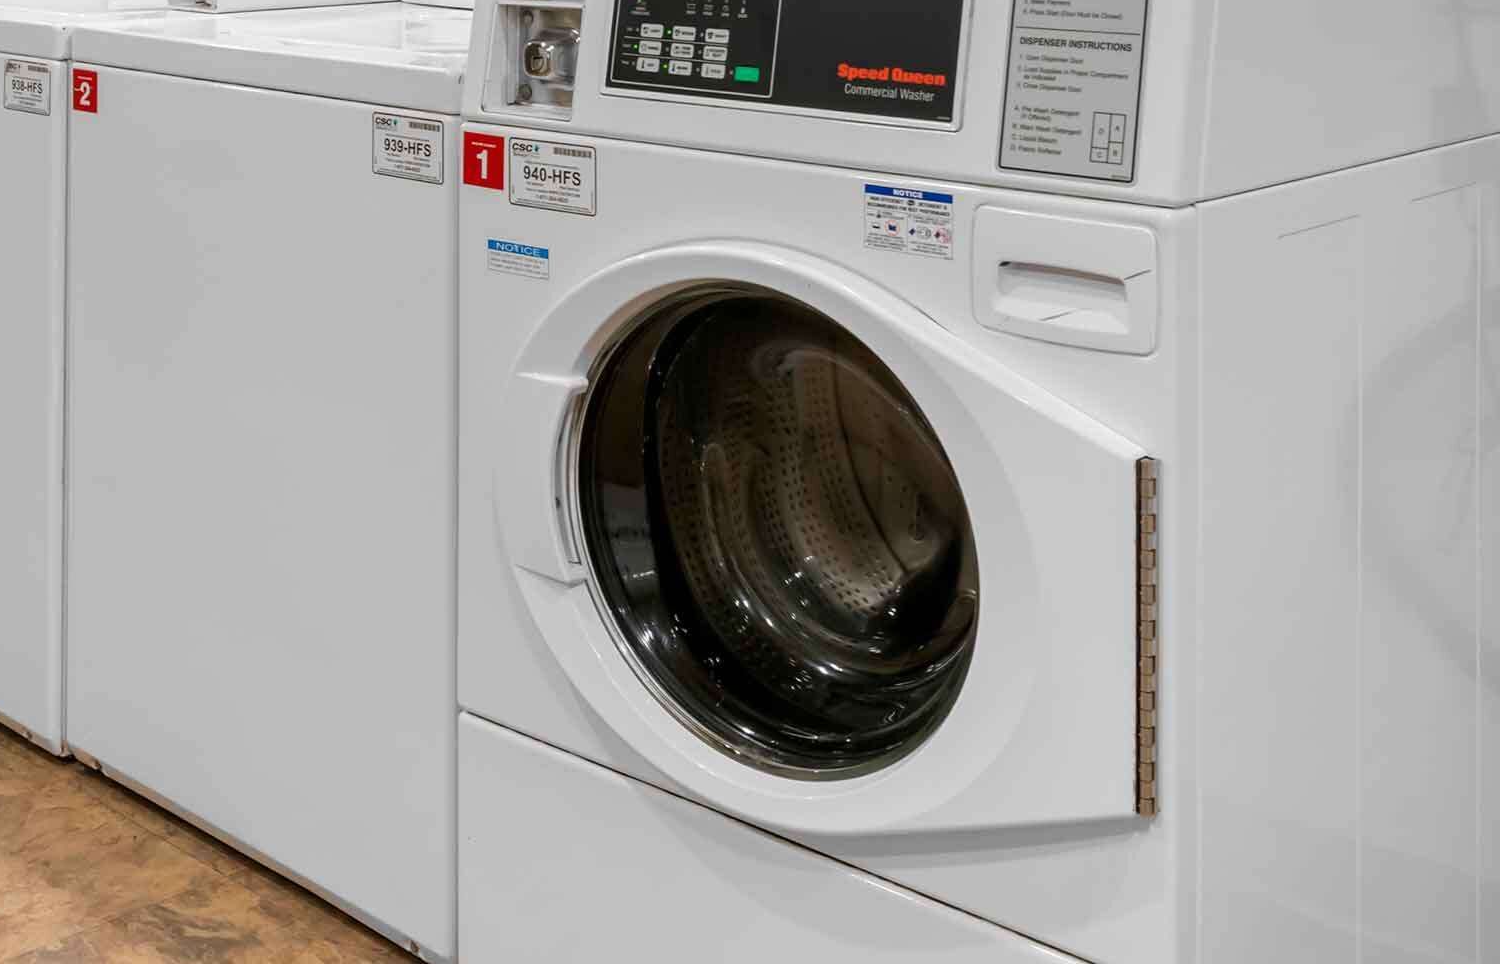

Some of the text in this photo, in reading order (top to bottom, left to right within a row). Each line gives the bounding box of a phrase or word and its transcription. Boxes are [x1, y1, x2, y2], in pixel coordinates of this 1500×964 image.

[1020, 36, 1132, 52] DISPENSER INSTRUCTIONS
[837, 62, 946, 86] Speed Queen
[11, 79, 43, 94] 938-HFS
[79, 81, 91, 107] 2
[844, 83, 935, 102] Commercial Washer
[375, 117, 392, 126] CSC
[384, 138, 432, 157] 939-HFS
[511, 142, 533, 153] CSC
[476, 149, 489, 180] 1
[523, 165, 582, 186] 940-HFS
[892, 188, 923, 199] NOTICE
[495, 242, 541, 257] NOTICE
